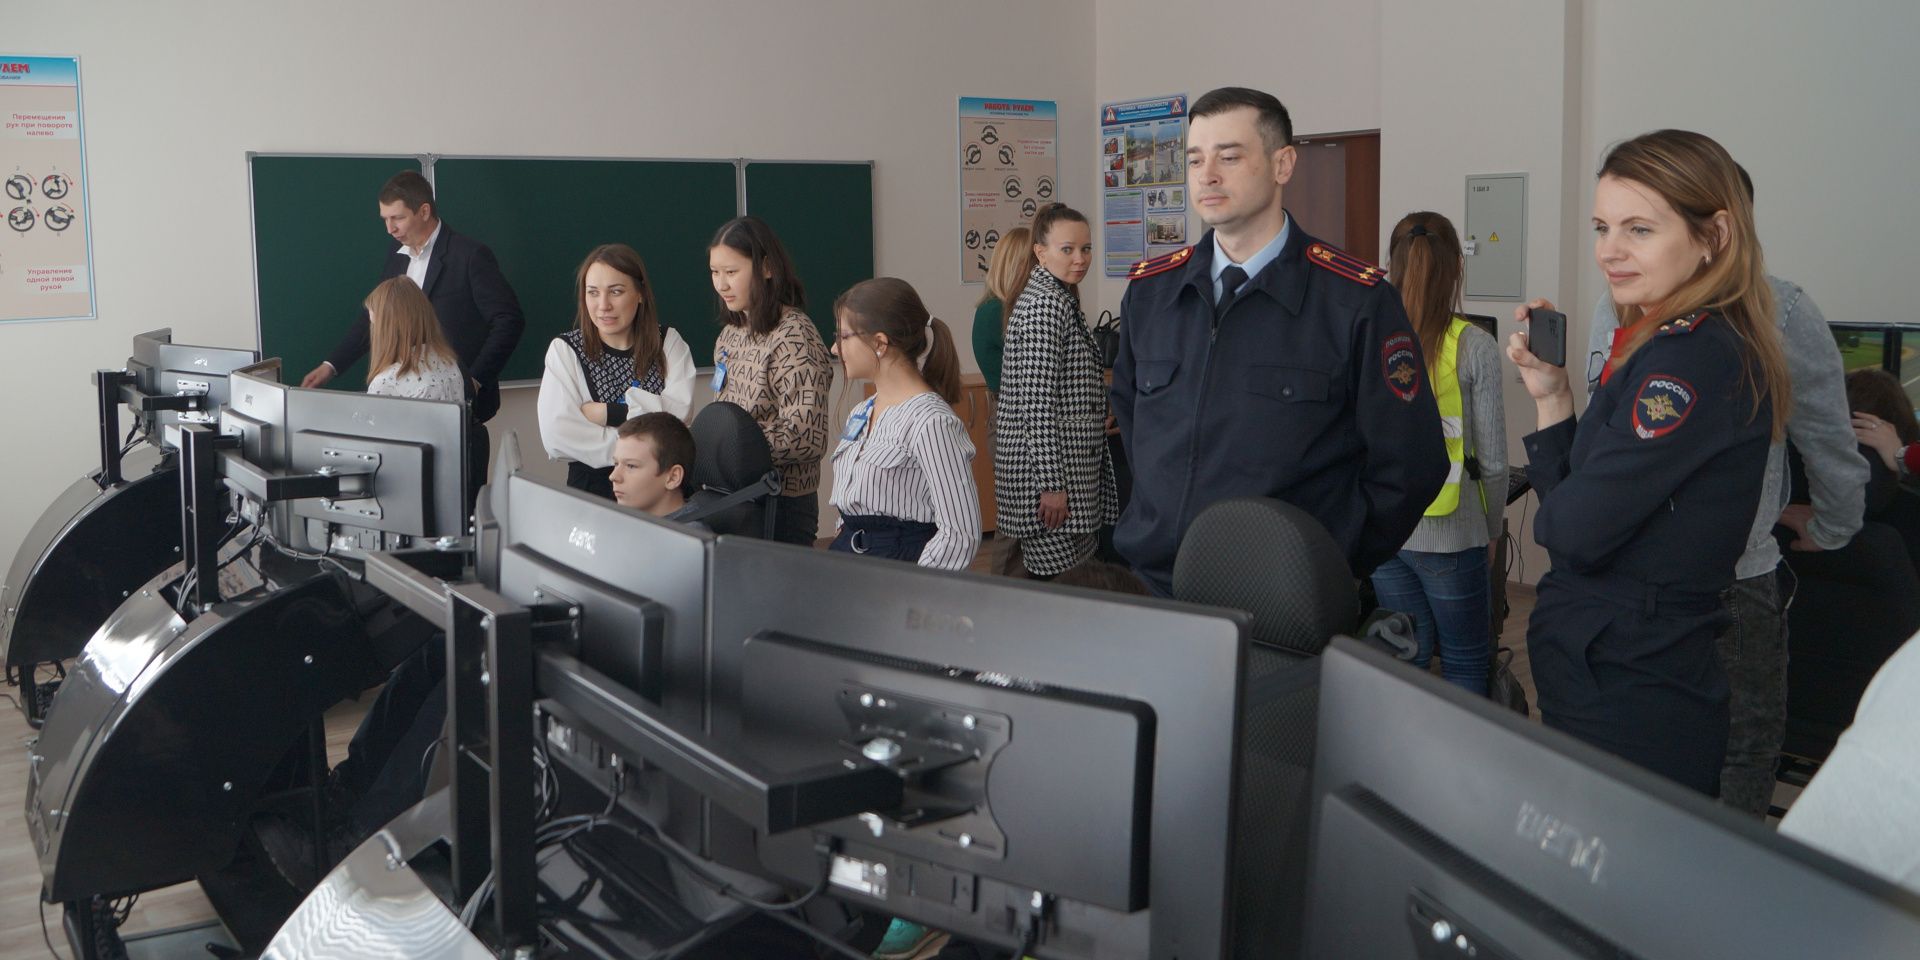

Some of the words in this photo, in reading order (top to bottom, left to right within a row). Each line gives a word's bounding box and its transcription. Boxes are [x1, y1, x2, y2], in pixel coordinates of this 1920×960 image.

[0, 63, 30, 73] ЛЕМ
[12, 113, 66, 121] Перемещения
[1388, 349, 1414, 365] РОССИЯ
[1649, 380, 1690, 404] РОССИЯ
